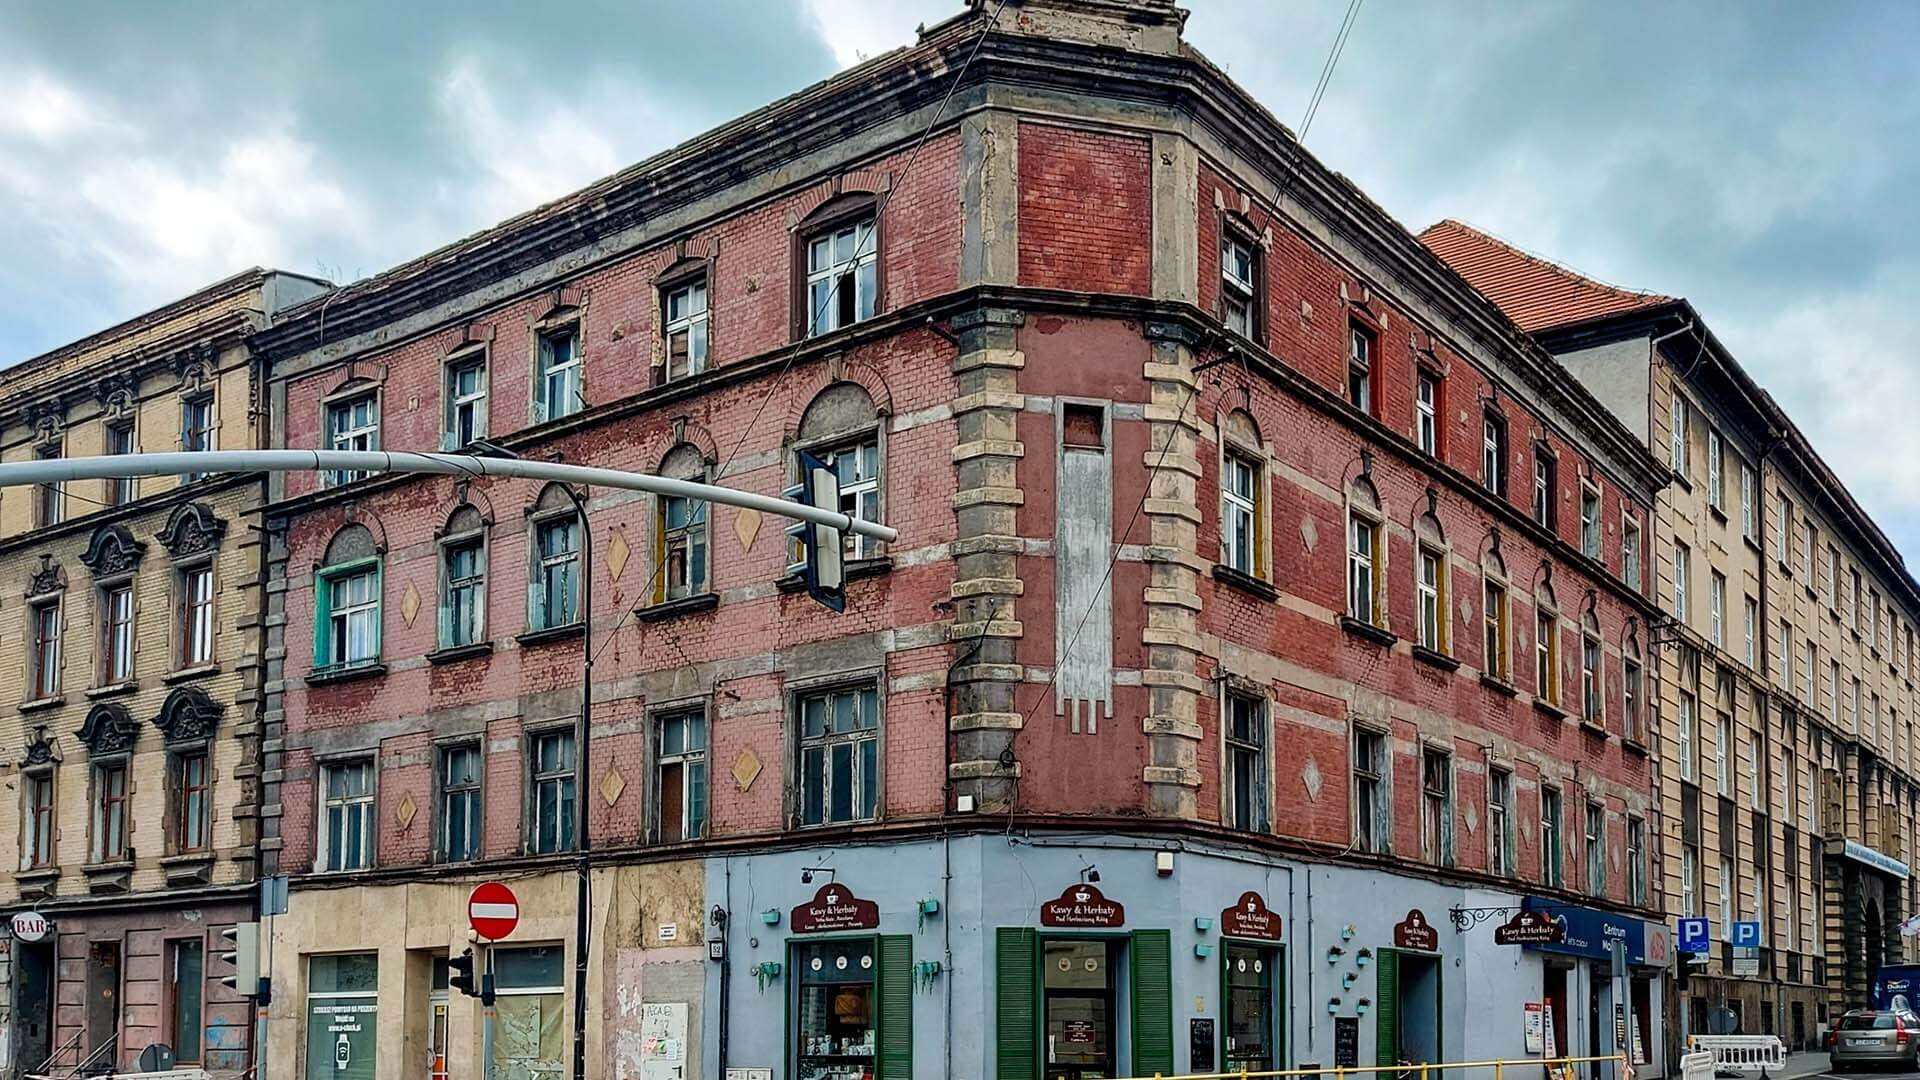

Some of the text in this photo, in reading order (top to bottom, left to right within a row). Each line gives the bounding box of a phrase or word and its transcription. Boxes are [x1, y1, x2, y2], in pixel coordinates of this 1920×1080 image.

[810, 907, 826, 917] Kawy
[833, 904, 857, 915] Herbaty
[1050, 904, 1115, 917] Kawy & Herbaty
[16, 919, 45, 933] BAR
[1502, 928, 1519, 937] Kawy
[1603, 924, 1626, 937] Centrum
[1685, 921, 1703, 942] P
[1738, 924, 1754, 943] P
